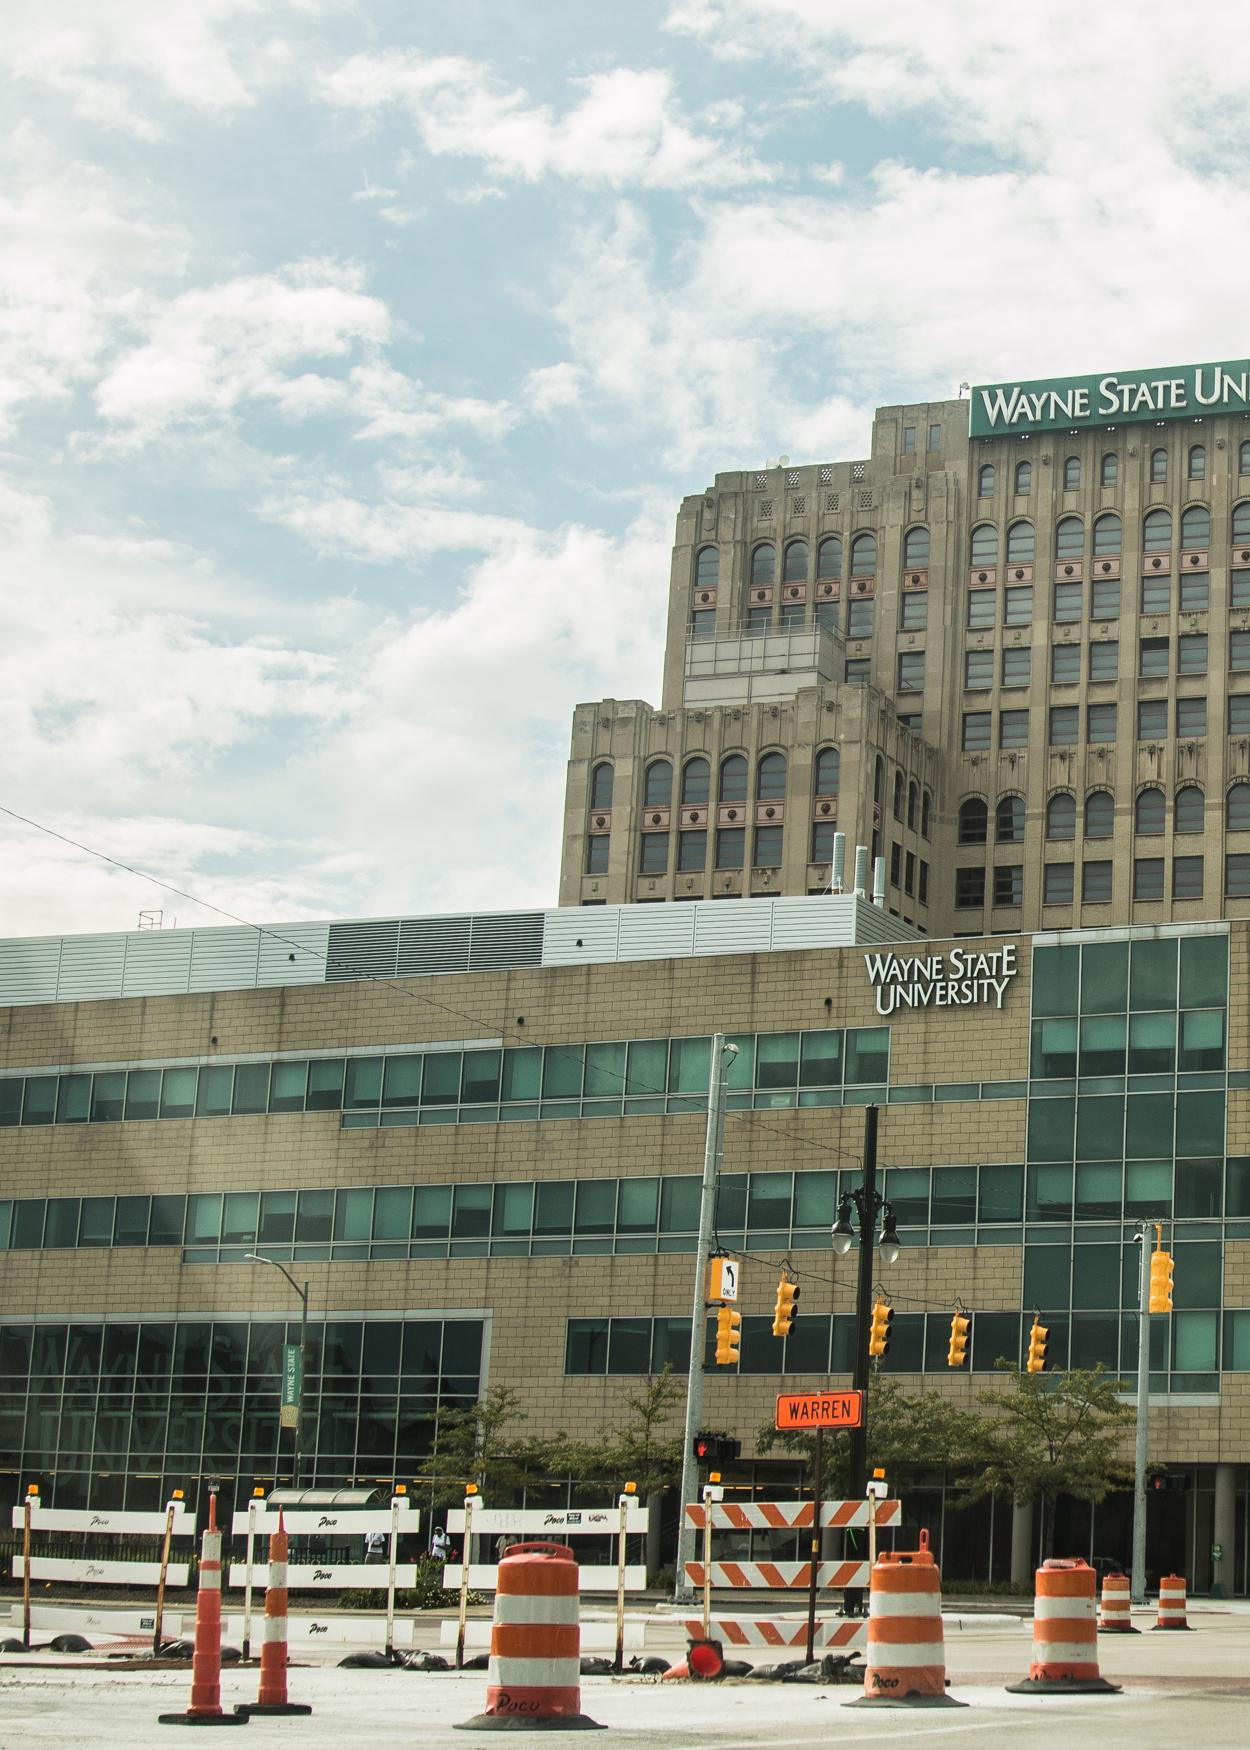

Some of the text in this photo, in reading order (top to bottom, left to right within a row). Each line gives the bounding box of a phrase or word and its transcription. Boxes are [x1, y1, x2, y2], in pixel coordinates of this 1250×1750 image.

[981, 386, 1091, 428] WAYNE
[1098, 376, 1187, 415] STATE
[864, 944, 1017, 985] WAYNE STATE
[875, 977, 1010, 1016] UNIVERSITY
[722, 1287, 736, 1297] ONLY
[286, 1348, 296, 1403] WAYNE STATE
[789, 1399, 851, 1420] WARREN
